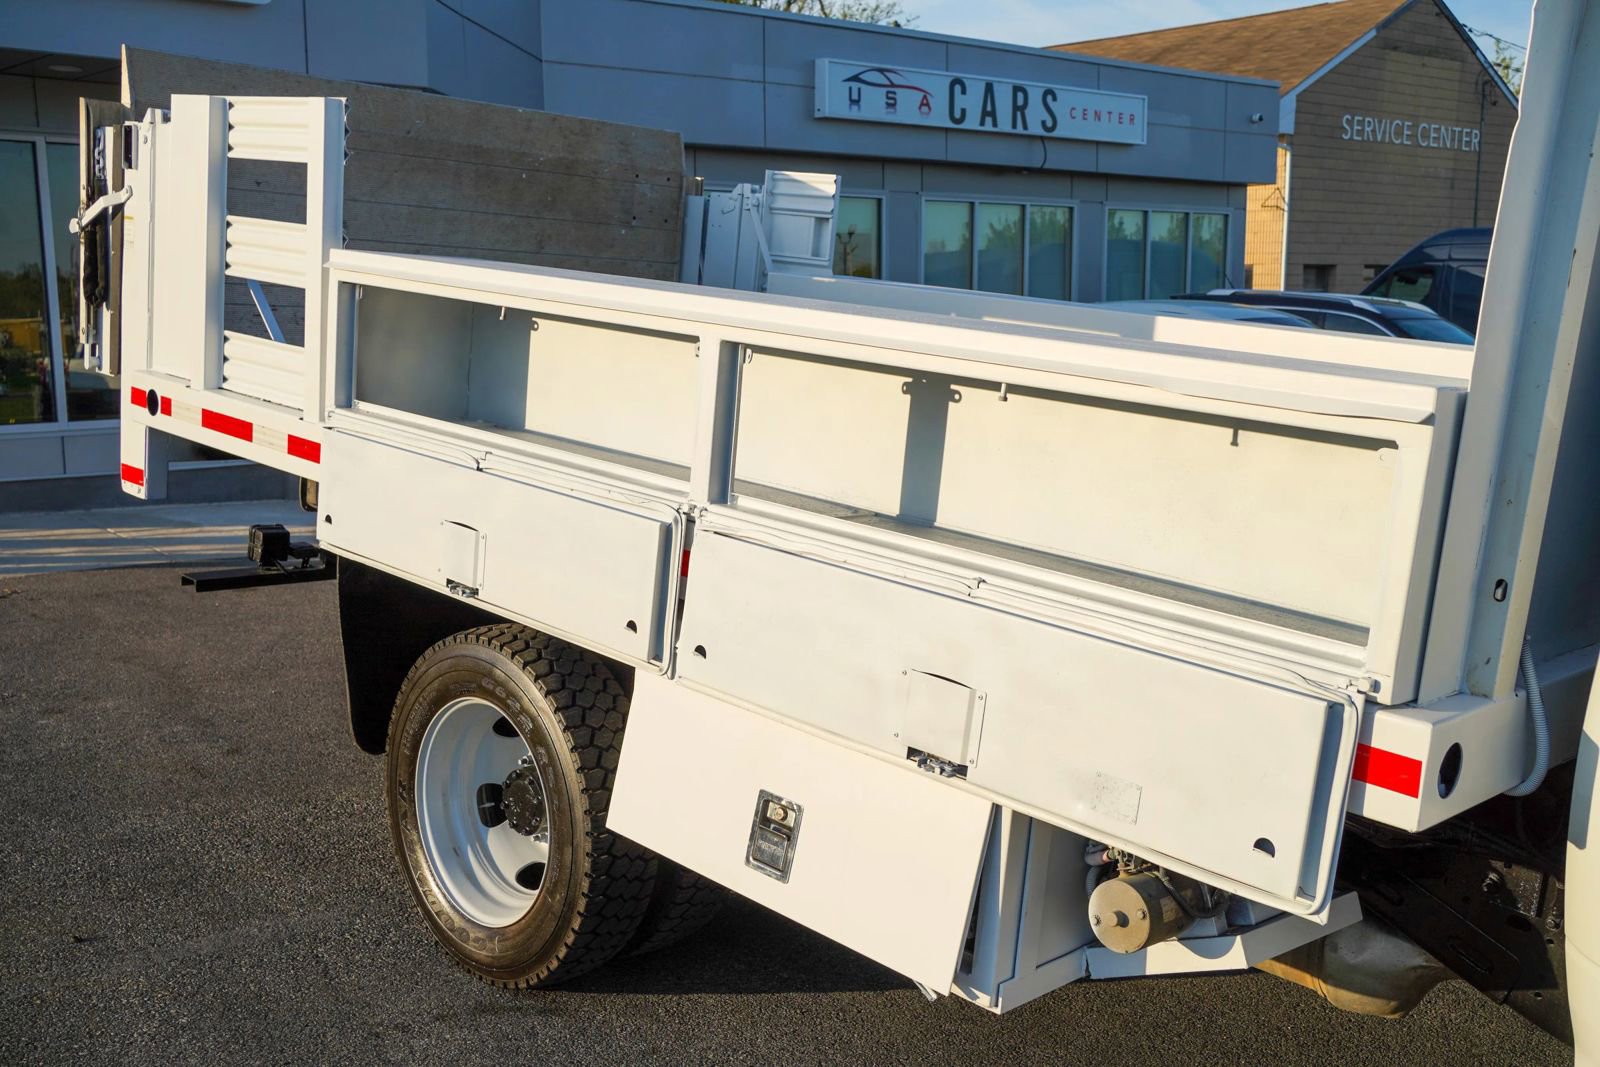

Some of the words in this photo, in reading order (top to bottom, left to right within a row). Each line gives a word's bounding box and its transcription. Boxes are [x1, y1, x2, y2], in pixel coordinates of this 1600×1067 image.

[848, 86, 932, 113] USA
[949, 77, 1058, 133] CARS
[1069, 106, 1136, 125] CENTER
[1342, 114, 1413, 145] SERVICE
[1417, 122, 1480, 152] CENTER
